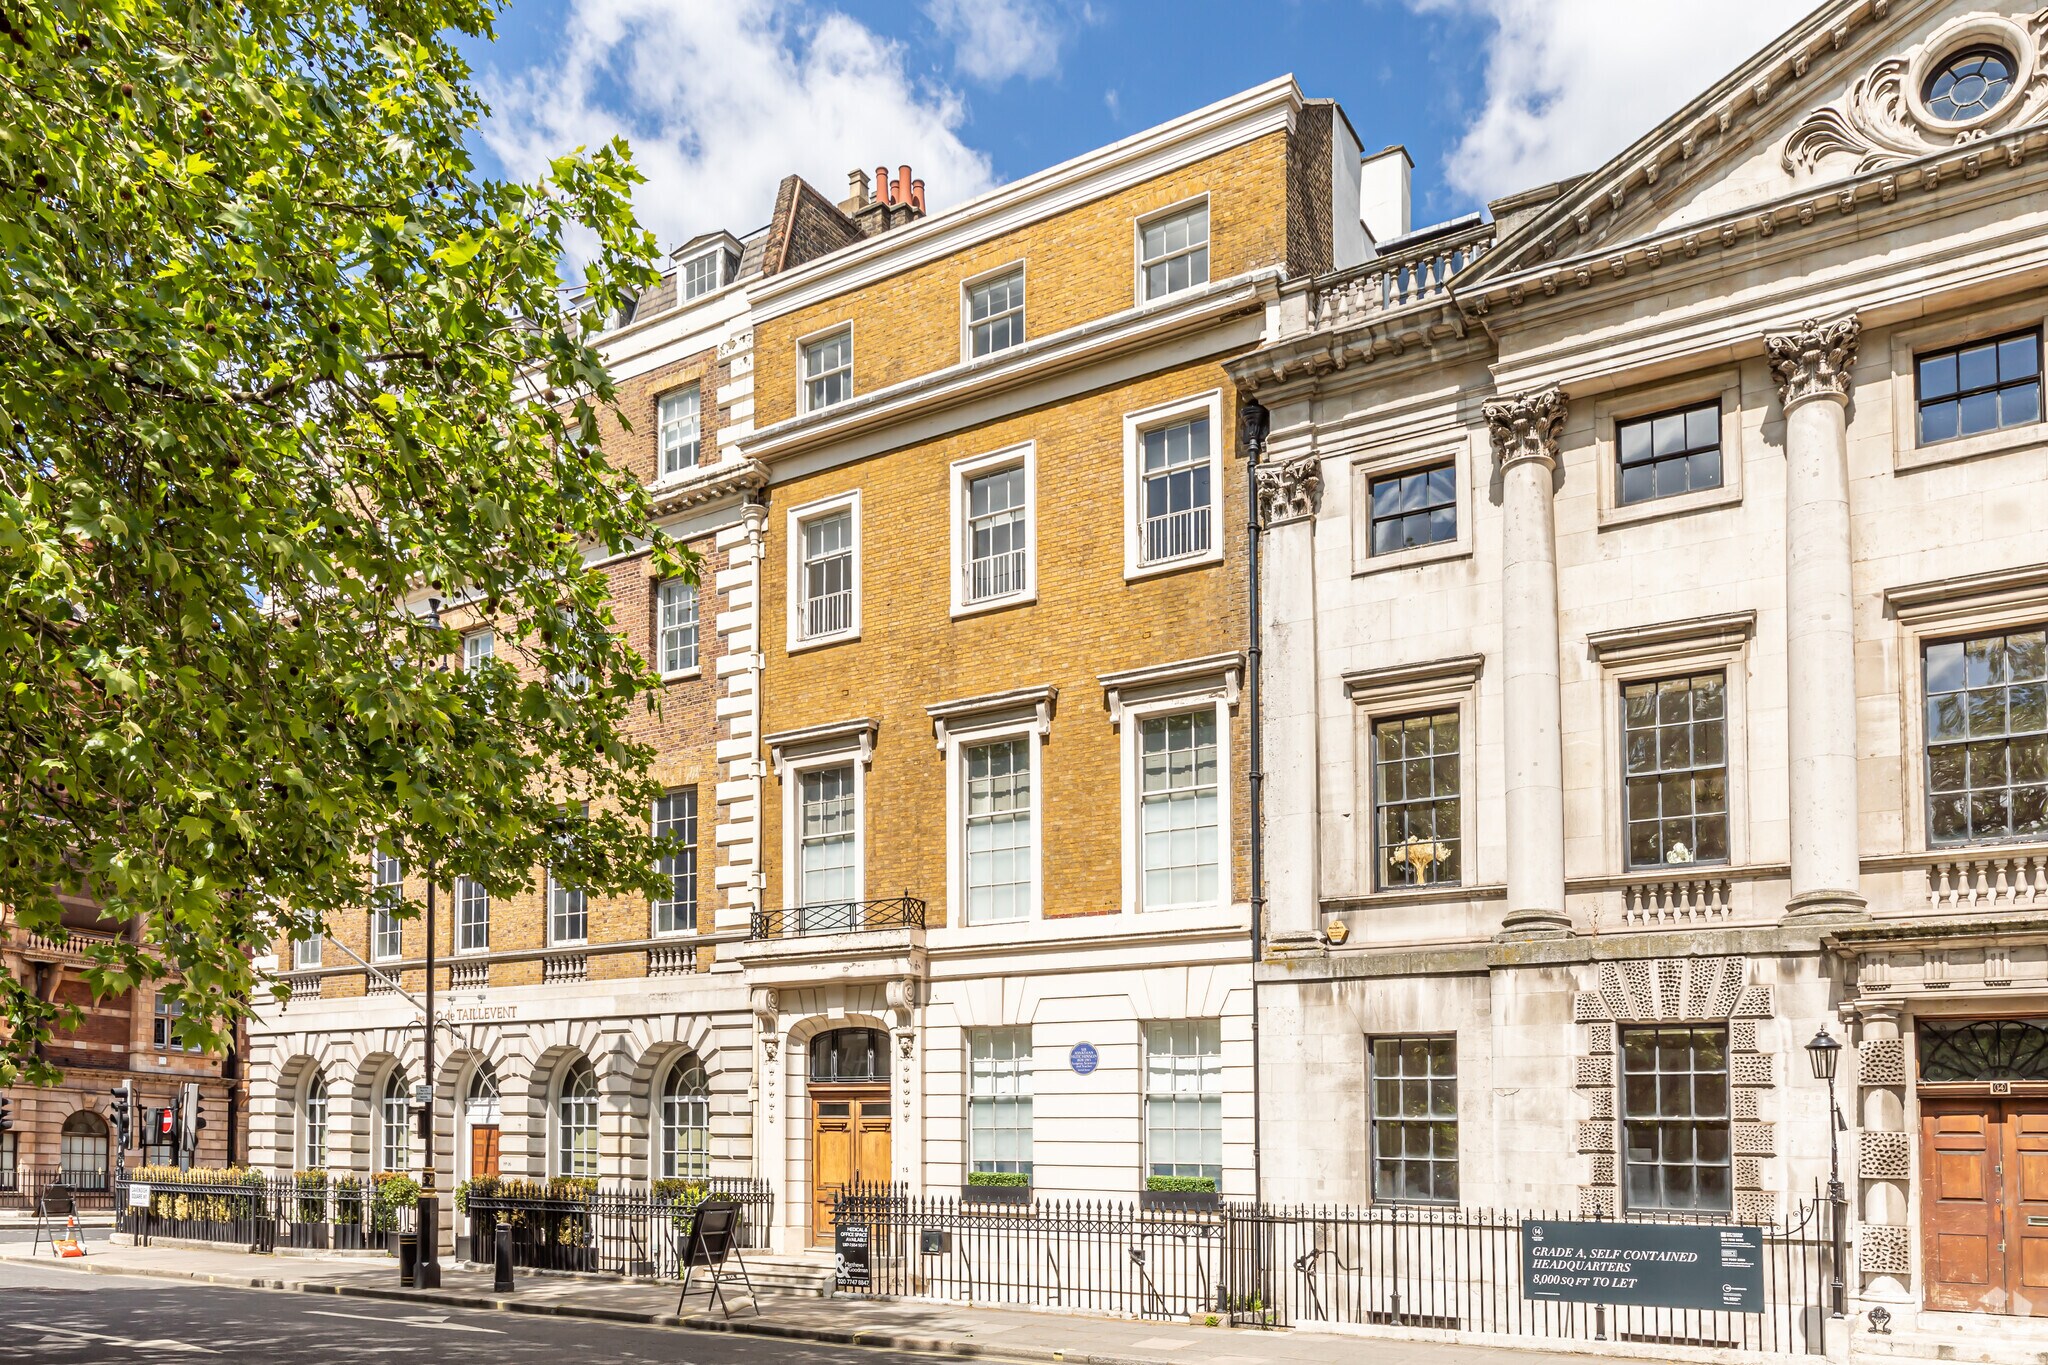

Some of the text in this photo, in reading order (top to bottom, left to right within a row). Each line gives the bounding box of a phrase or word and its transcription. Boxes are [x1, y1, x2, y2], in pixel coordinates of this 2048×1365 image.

[445, 1009, 455, 1021] de
[456, 1006, 517, 1021] TAILLEVENT
[1532, 1246, 1698, 1262] GRADE A, SELF CONTAINED
[835, 1253, 850, 1278] &
[1532, 1260, 1631, 1272] HEADQUARTERS
[1532, 1274, 1638, 1288] 8,000 SQ FT TO LET
